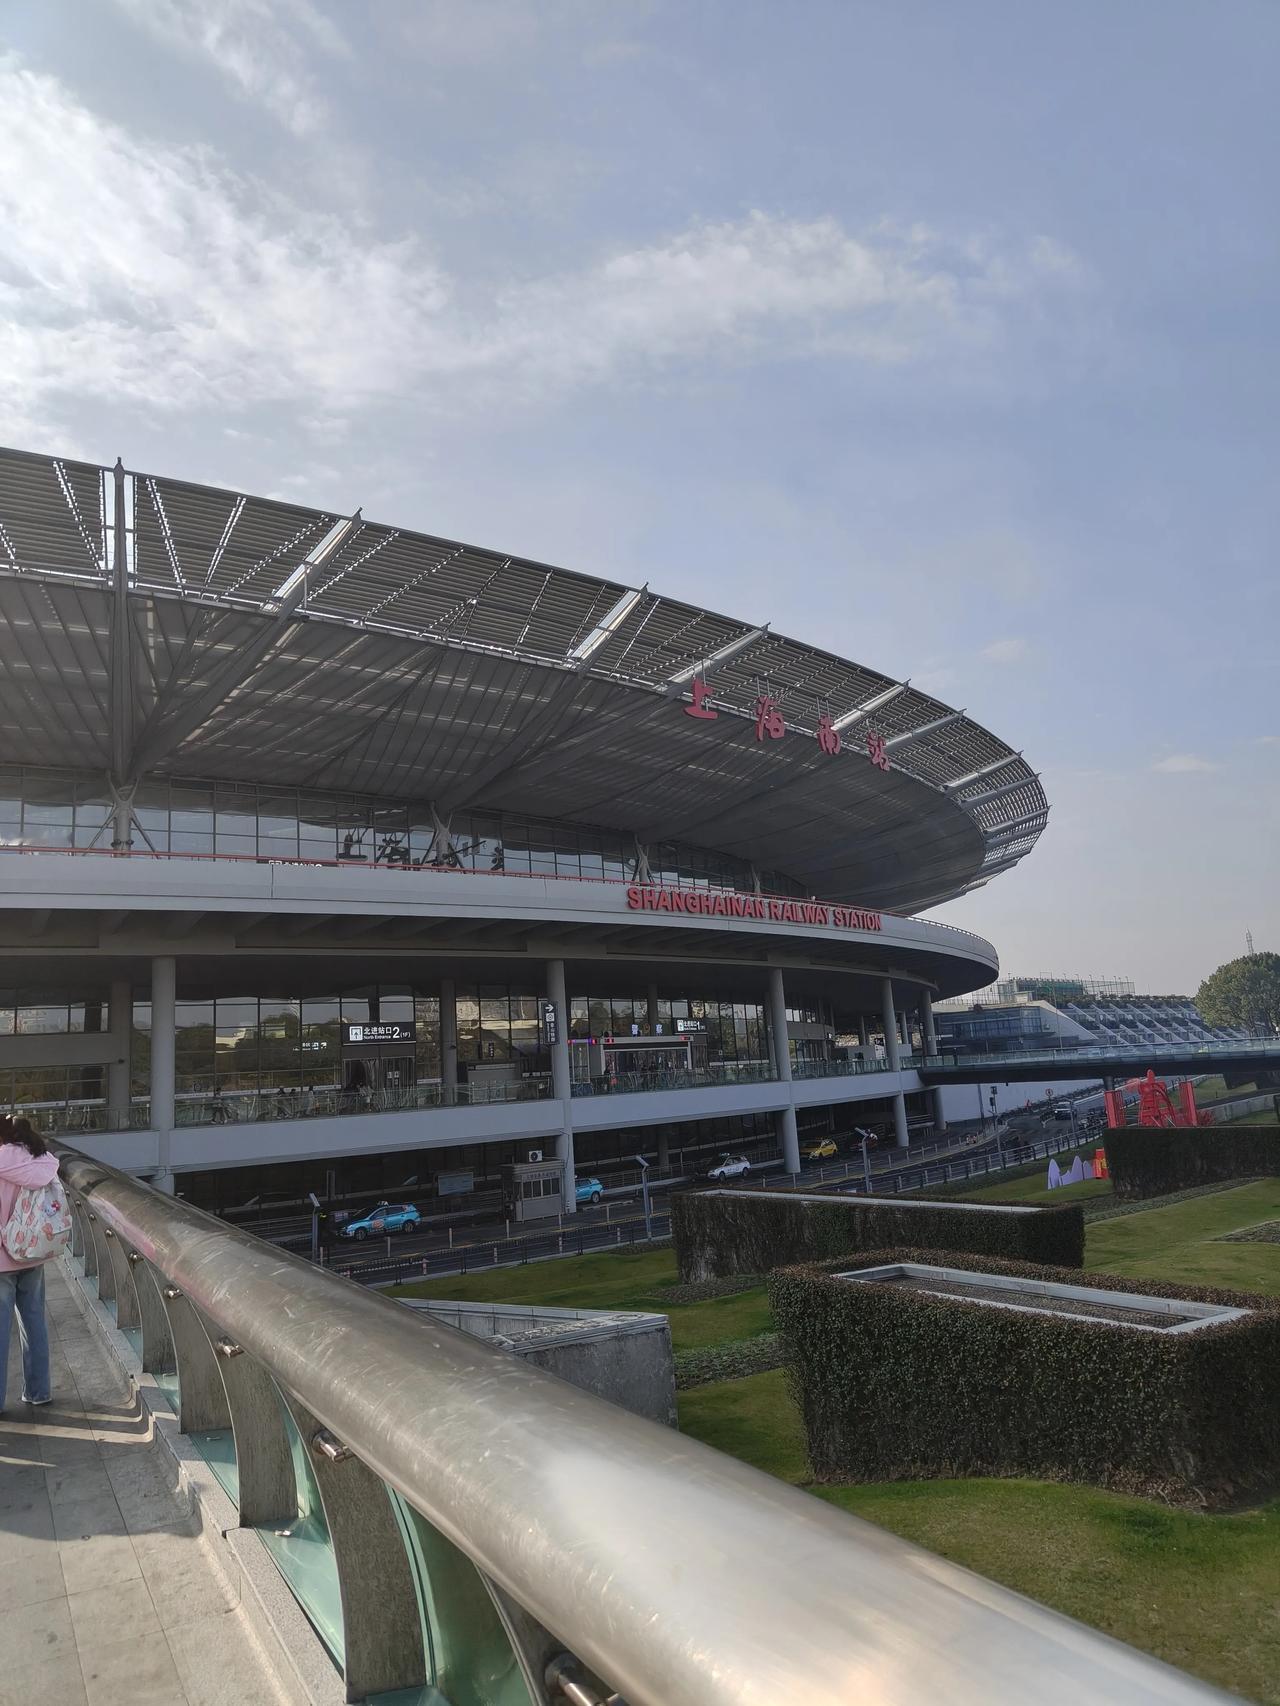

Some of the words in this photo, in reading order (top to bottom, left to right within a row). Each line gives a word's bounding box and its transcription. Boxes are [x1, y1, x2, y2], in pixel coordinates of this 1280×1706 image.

[683, 677, 890, 772] 上海南站
[627, 887, 766, 918] SHANGHAINAN
[768, 901, 831, 924] RAILWAY
[833, 908, 882, 931] STATION
[364, 1026, 392, 1034] 北进站口
[392, 1026, 400, 1038] 2
